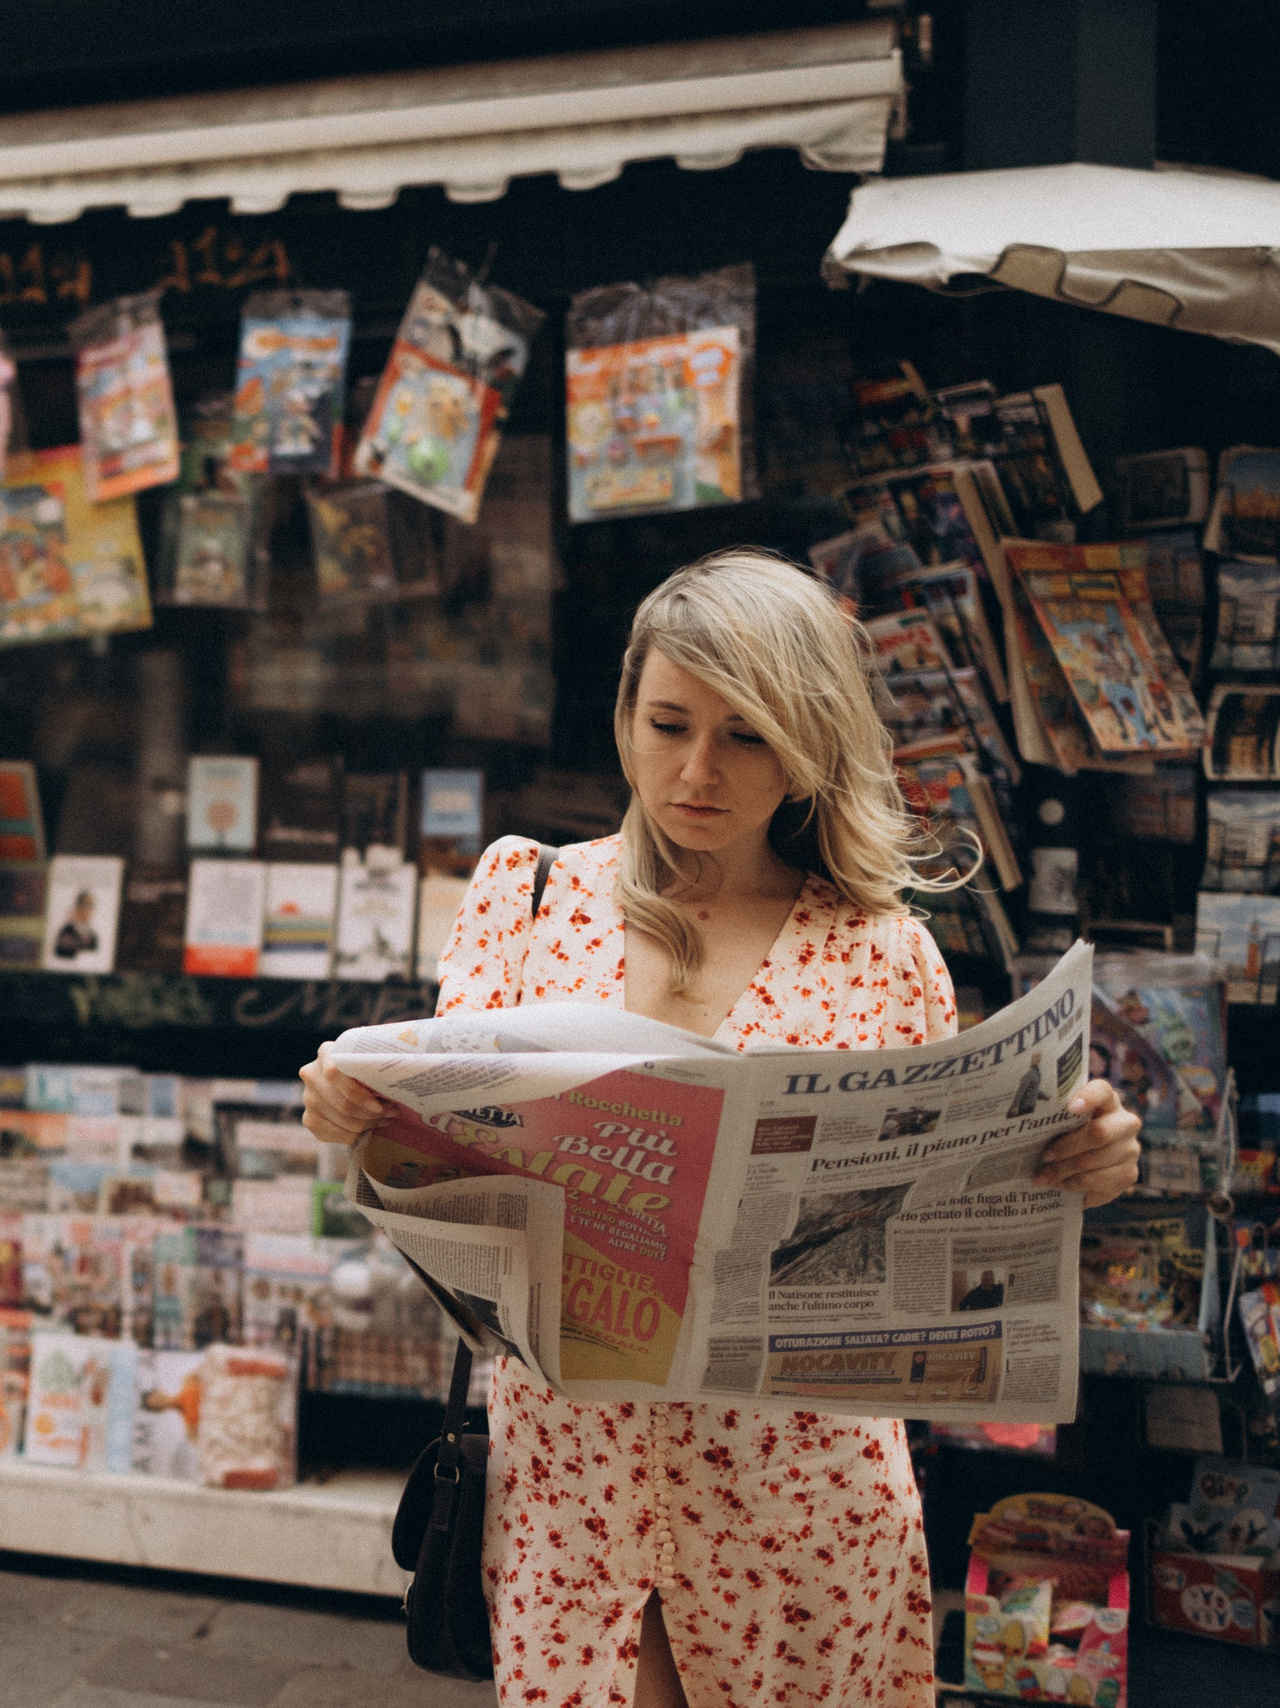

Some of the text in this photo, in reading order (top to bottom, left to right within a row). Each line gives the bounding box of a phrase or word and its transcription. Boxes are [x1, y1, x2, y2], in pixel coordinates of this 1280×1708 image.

[782, 1072, 831, 1096] IL
[838, 988, 1075, 1093] GAZZETTINO
[568, 1090, 684, 1127] Rocchetta
[593, 1121, 681, 1156] Più
[811, 1146, 901, 1172] Pensioni,
[904, 1142, 920, 1158] il
[920, 1131, 978, 1159] piano
[979, 1124, 1016, 1146] per
[552, 1134, 676, 1185] Bella
[977, 1192, 1003, 1206] fuga
[1005, 1190, 1018, 1203] di
[1020, 1188, 1062, 1202] Turetta
[570, 1204, 617, 1224] QUATTRO
[919, 1208, 963, 1223] gettato
[964, 1206, 973, 1219] il
[974, 1204, 1019, 1218] coltello
[1020, 1207, 1027, 1216] a
[579, 1217, 591, 1227] TE
[593, 1221, 607, 1232] NE
[609, 1227, 668, 1251] REGALIAMO
[607, 1237, 667, 1261] ALTRE DUE!
[768, 1287, 881, 1301] Il Natisone restituisce
[768, 1299, 875, 1312] anche l'ultimo corpo
[774, 1335, 843, 1349] OTTURAZIONE
[844, 1333, 890, 1346] SALTATA?
[891, 1330, 927, 1344] CARIE?
[928, 1327, 959, 1341] DENTE
[959, 1324, 997, 1338] ROTTO?
[781, 1351, 897, 1372] NOCAVITY
[928, 1350, 976, 1361] NOCAVITY
